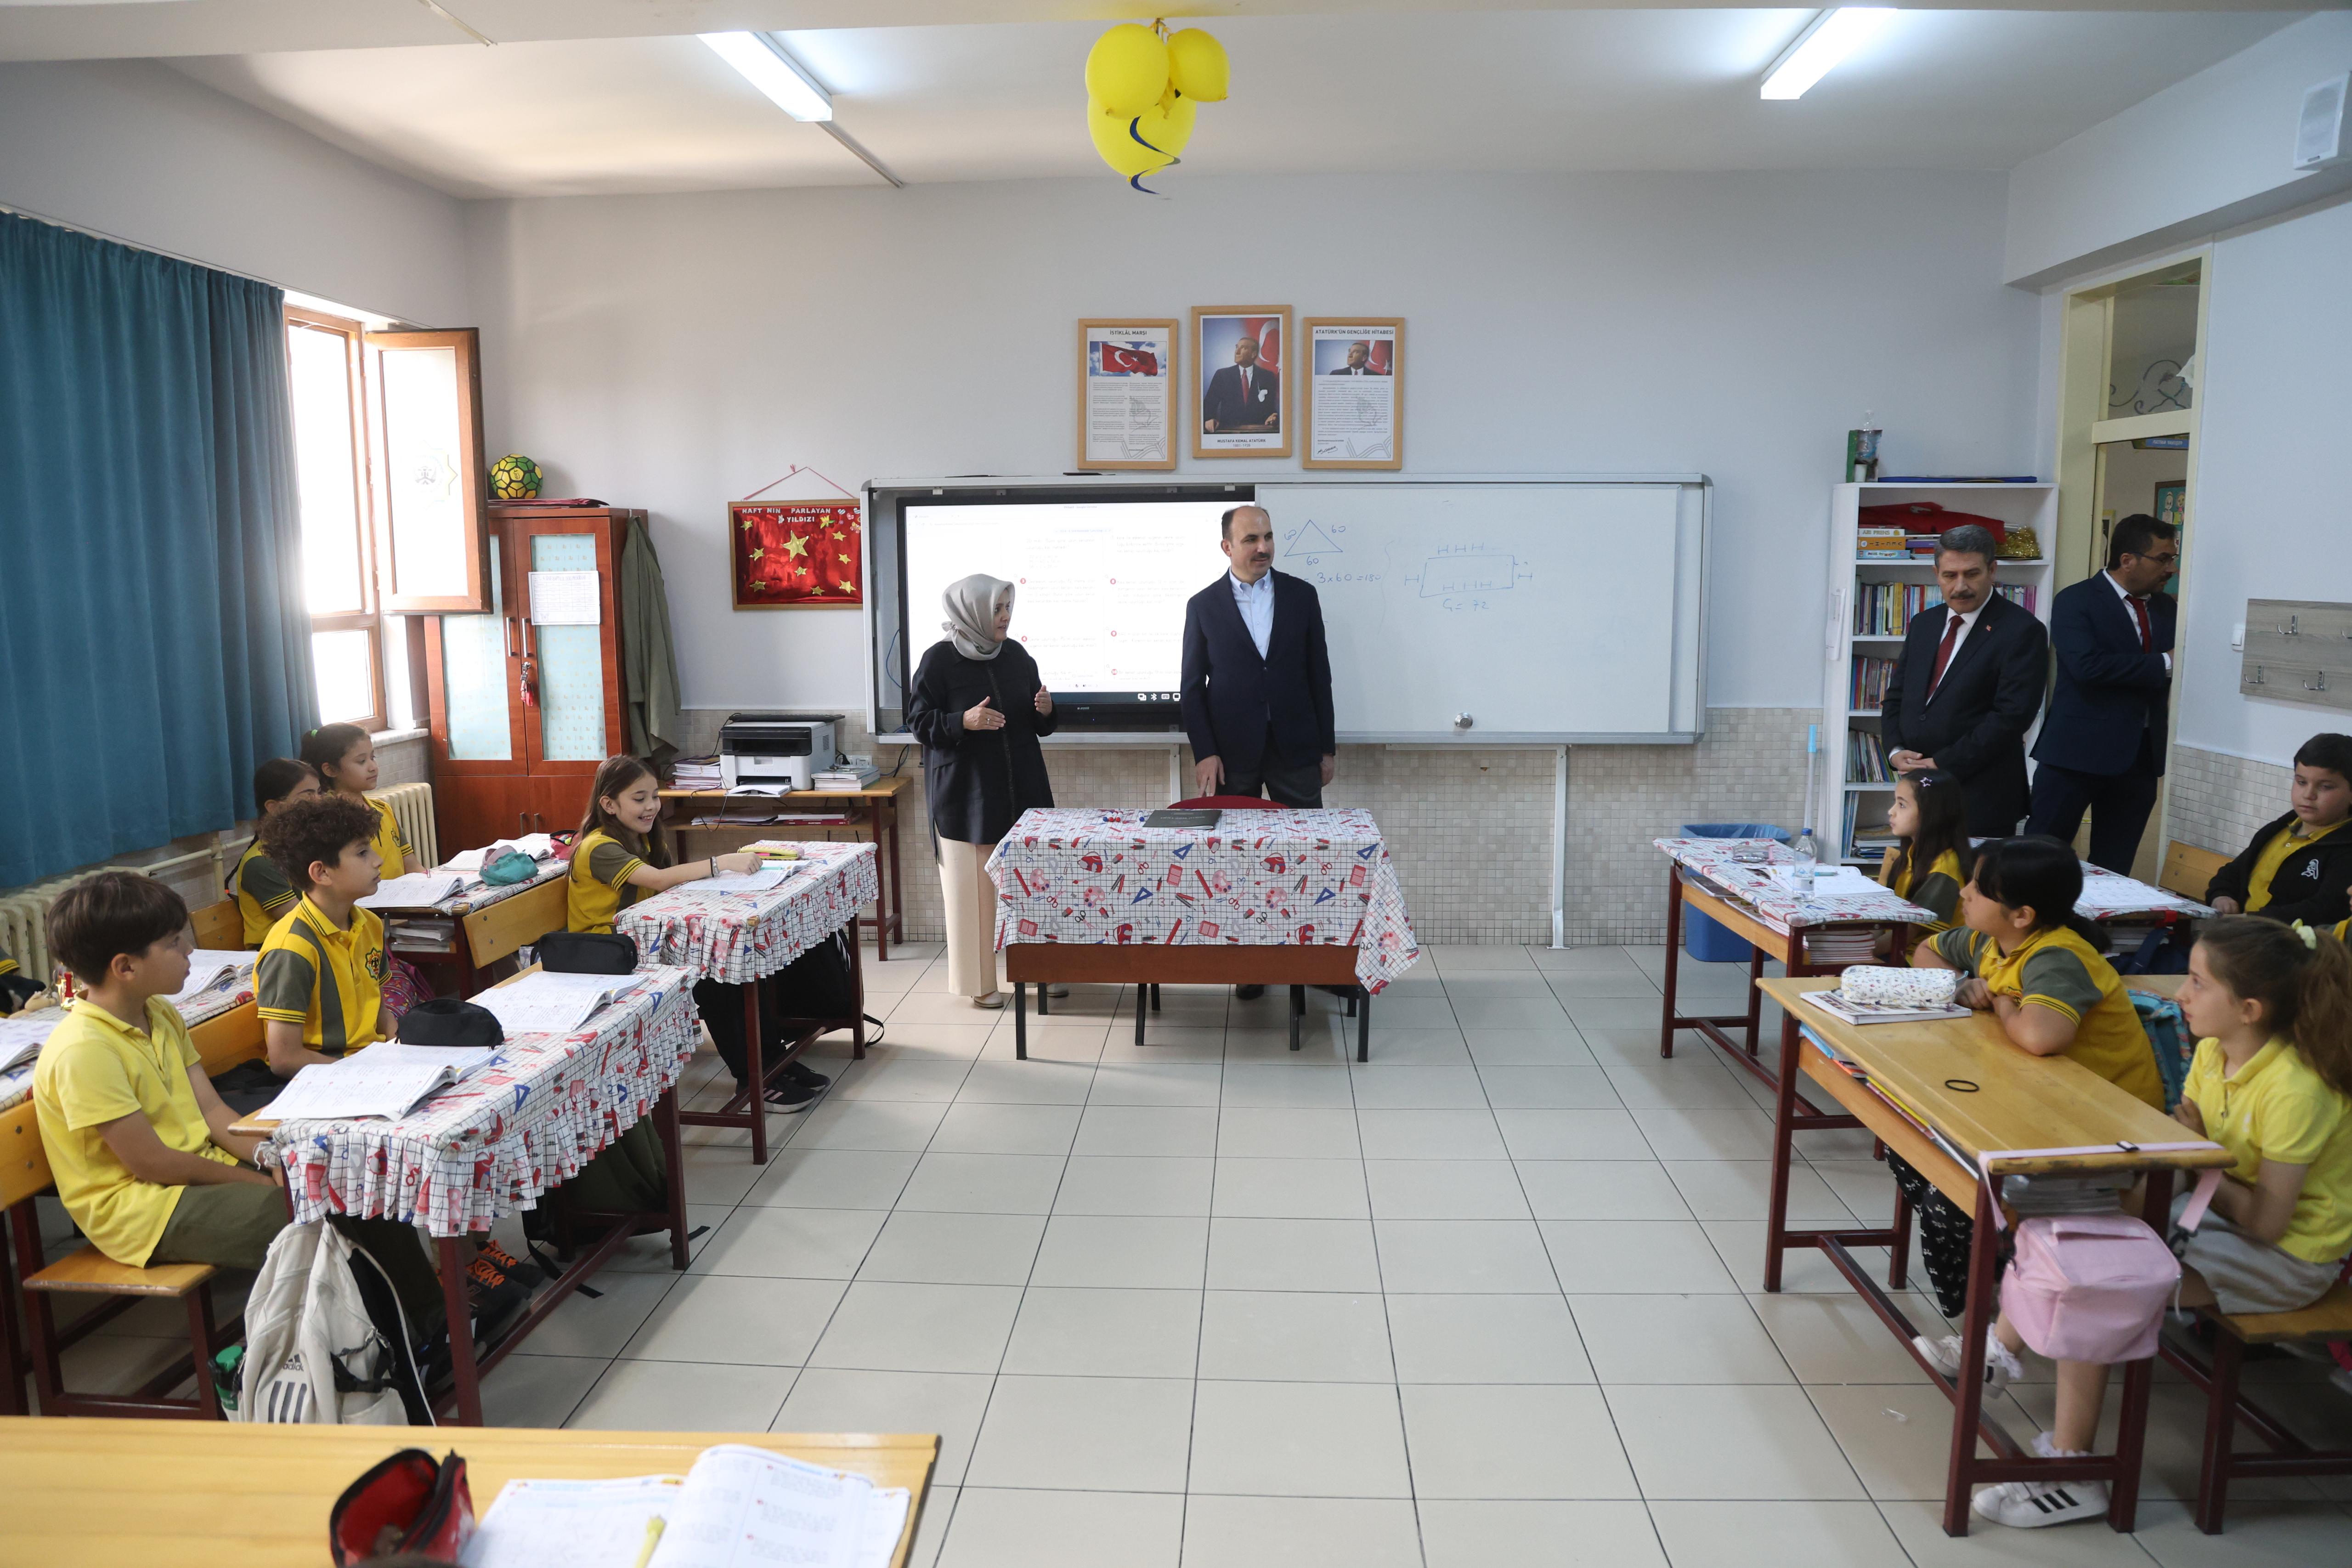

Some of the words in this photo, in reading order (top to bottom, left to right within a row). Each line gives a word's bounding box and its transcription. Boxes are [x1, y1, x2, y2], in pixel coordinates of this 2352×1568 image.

[1332, 525, 1346, 533] 60
[1284, 529, 1296, 540] 60
[1306, 555, 1319, 566] 60
[283, 1363, 304, 1371] adid
